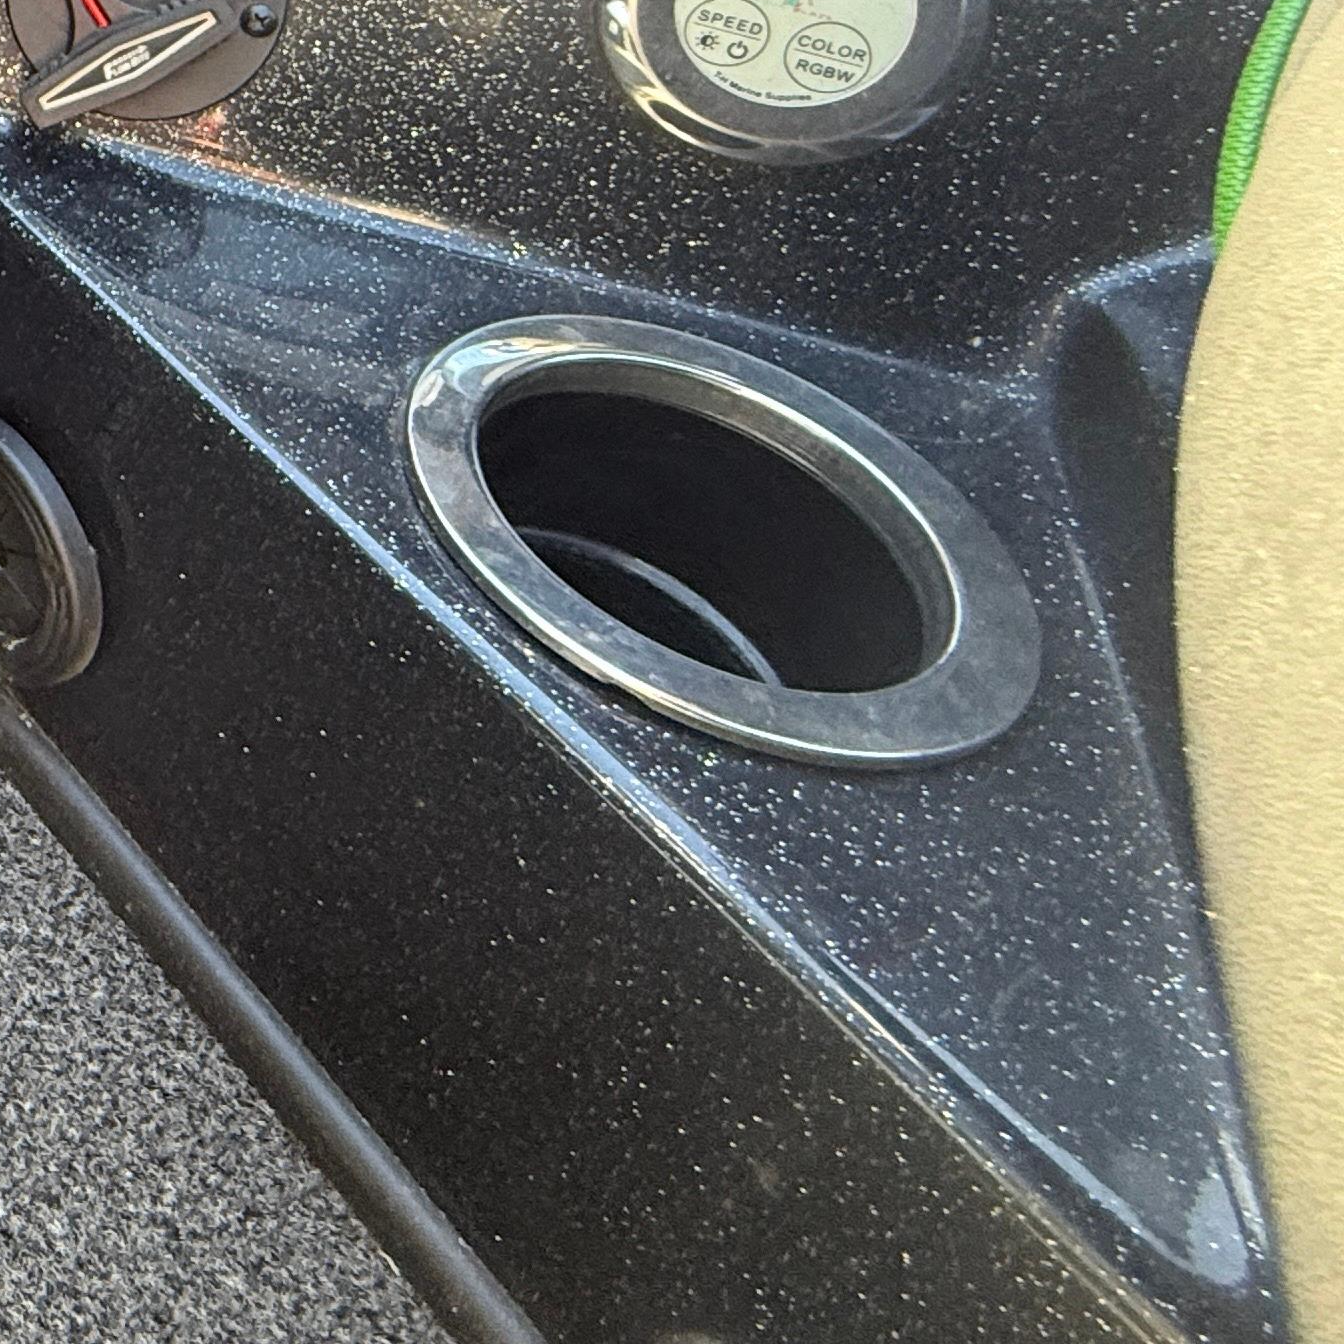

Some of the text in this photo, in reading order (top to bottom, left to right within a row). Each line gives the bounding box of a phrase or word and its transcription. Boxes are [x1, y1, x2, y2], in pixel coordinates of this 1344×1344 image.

[697, 8, 763, 36] SPEED
[797, 34, 867, 63] COLOR
[795, 58, 856, 83] RGBW
[729, 81, 762, 97] Marine
[765, 91, 812, 102] Supplies
